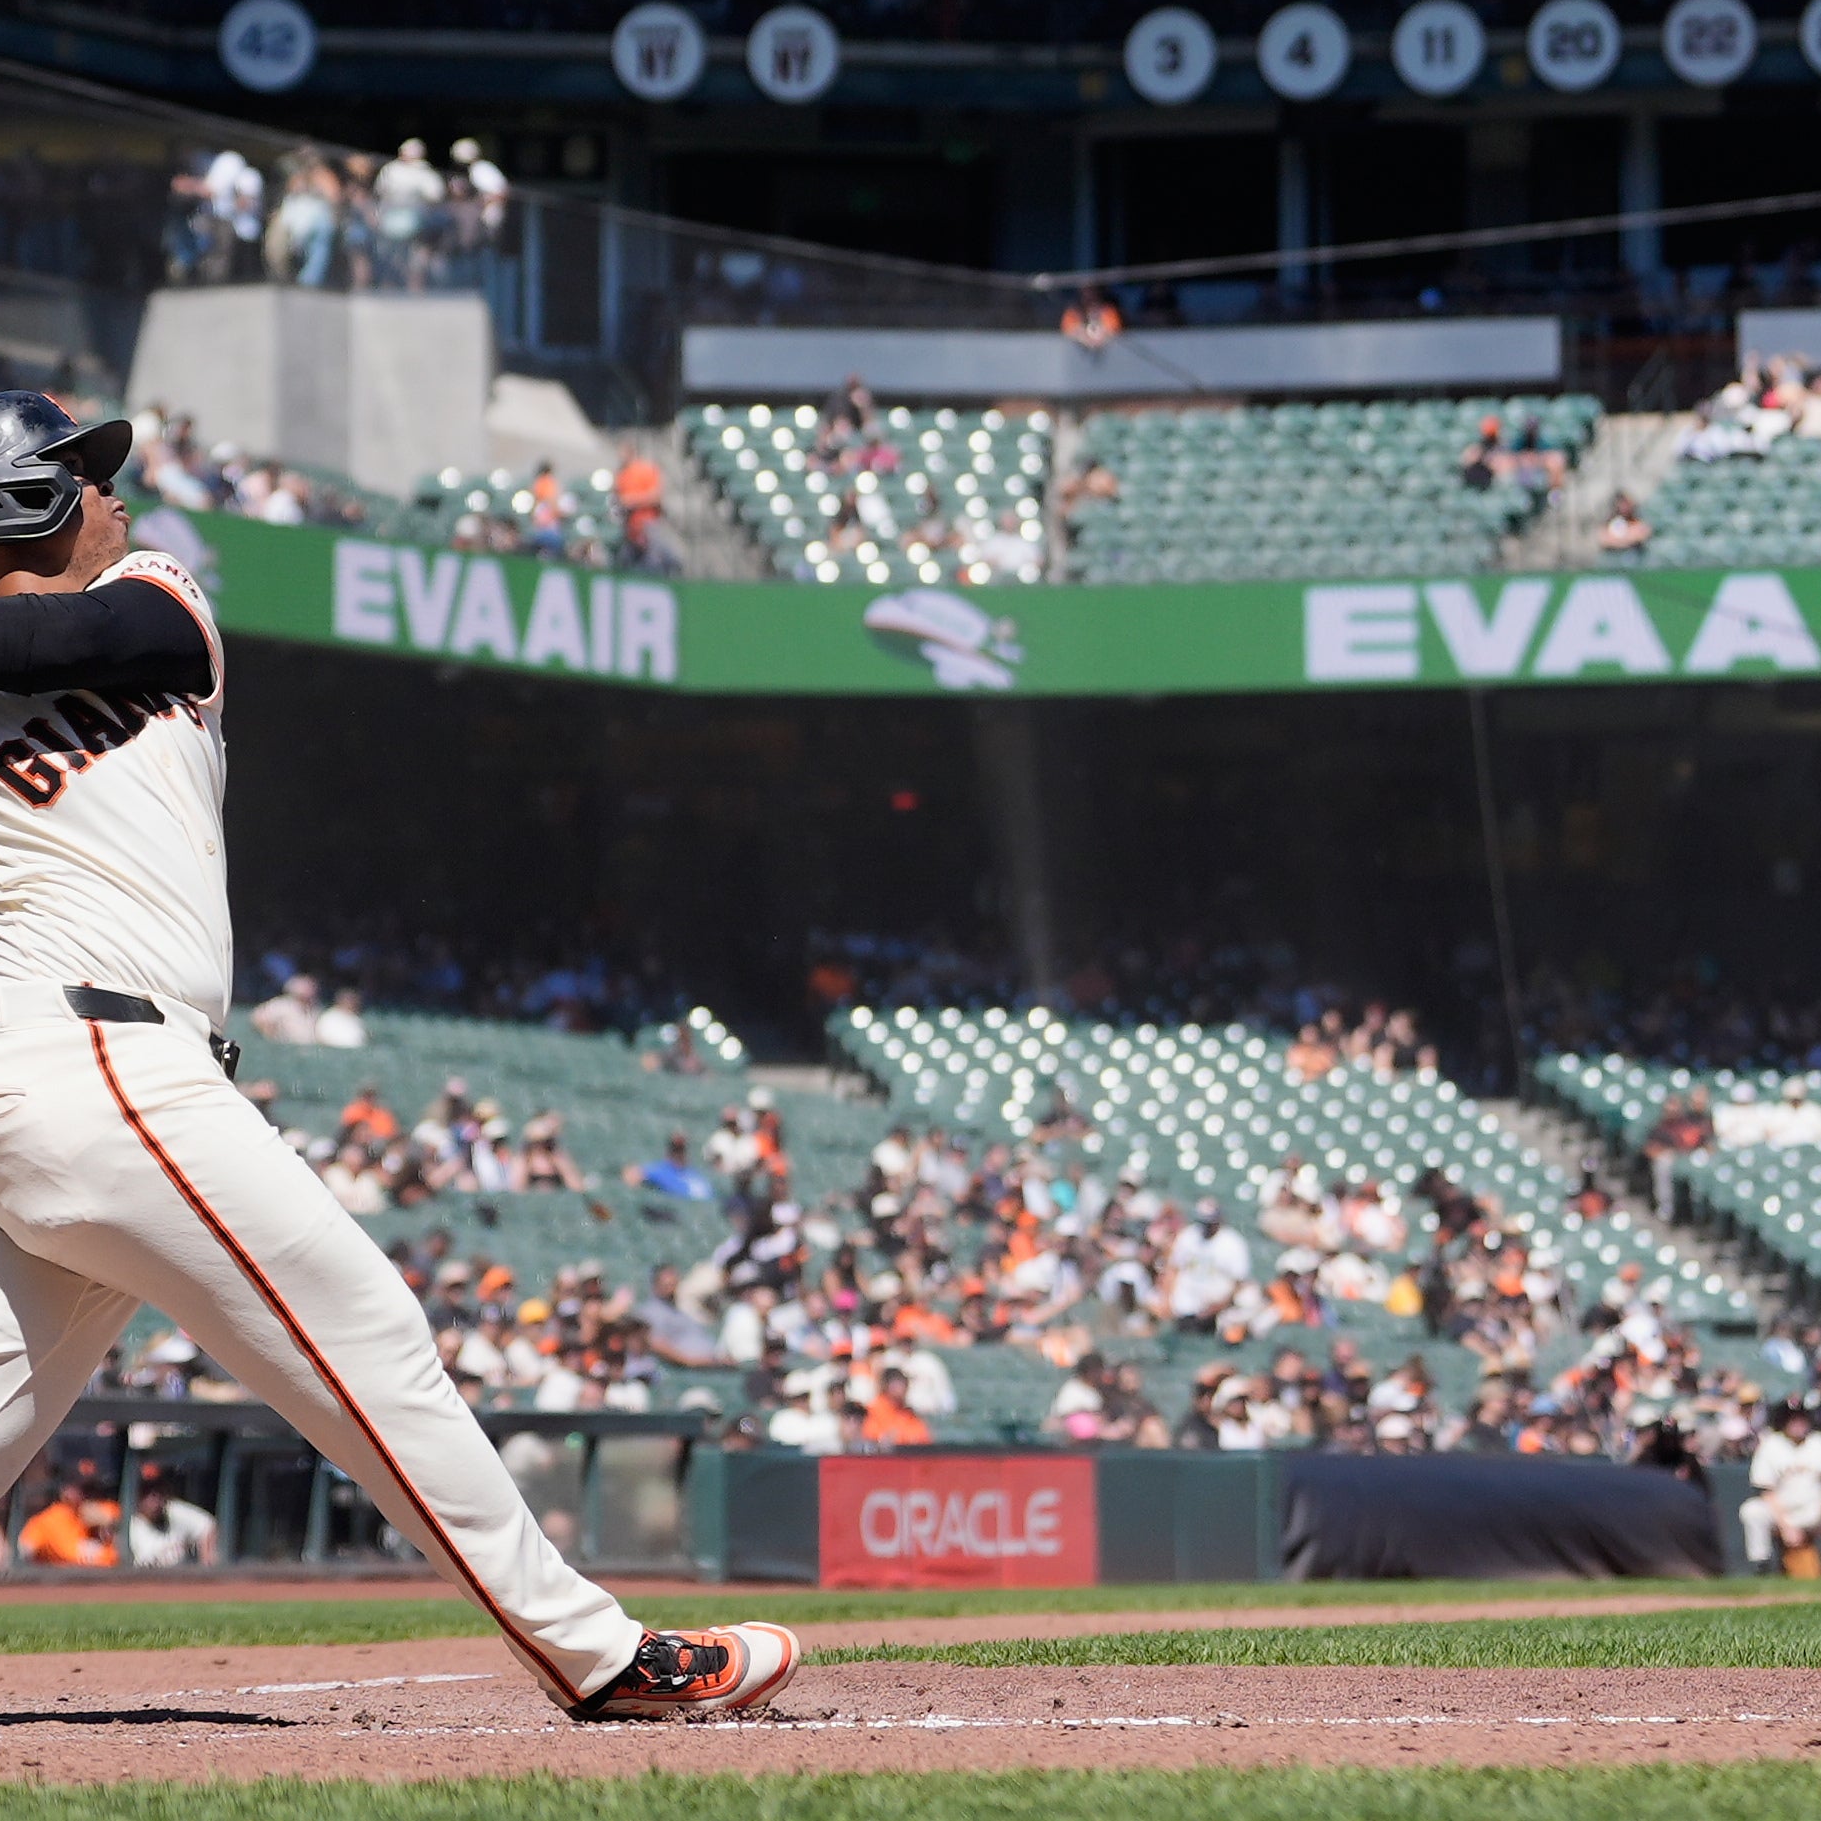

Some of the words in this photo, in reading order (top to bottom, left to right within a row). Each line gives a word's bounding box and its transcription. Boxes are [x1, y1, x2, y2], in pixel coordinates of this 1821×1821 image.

[236, 23, 296, 60] 42
[1155, 36, 1180, 75] 3
[1286, 32, 1314, 69] 4
[1420, 28, 1456, 68] 11
[1547, 22, 1601, 64] 20
[1681, 15, 1738, 59] 22
[860, 1487, 1062, 1559] ORACLE
